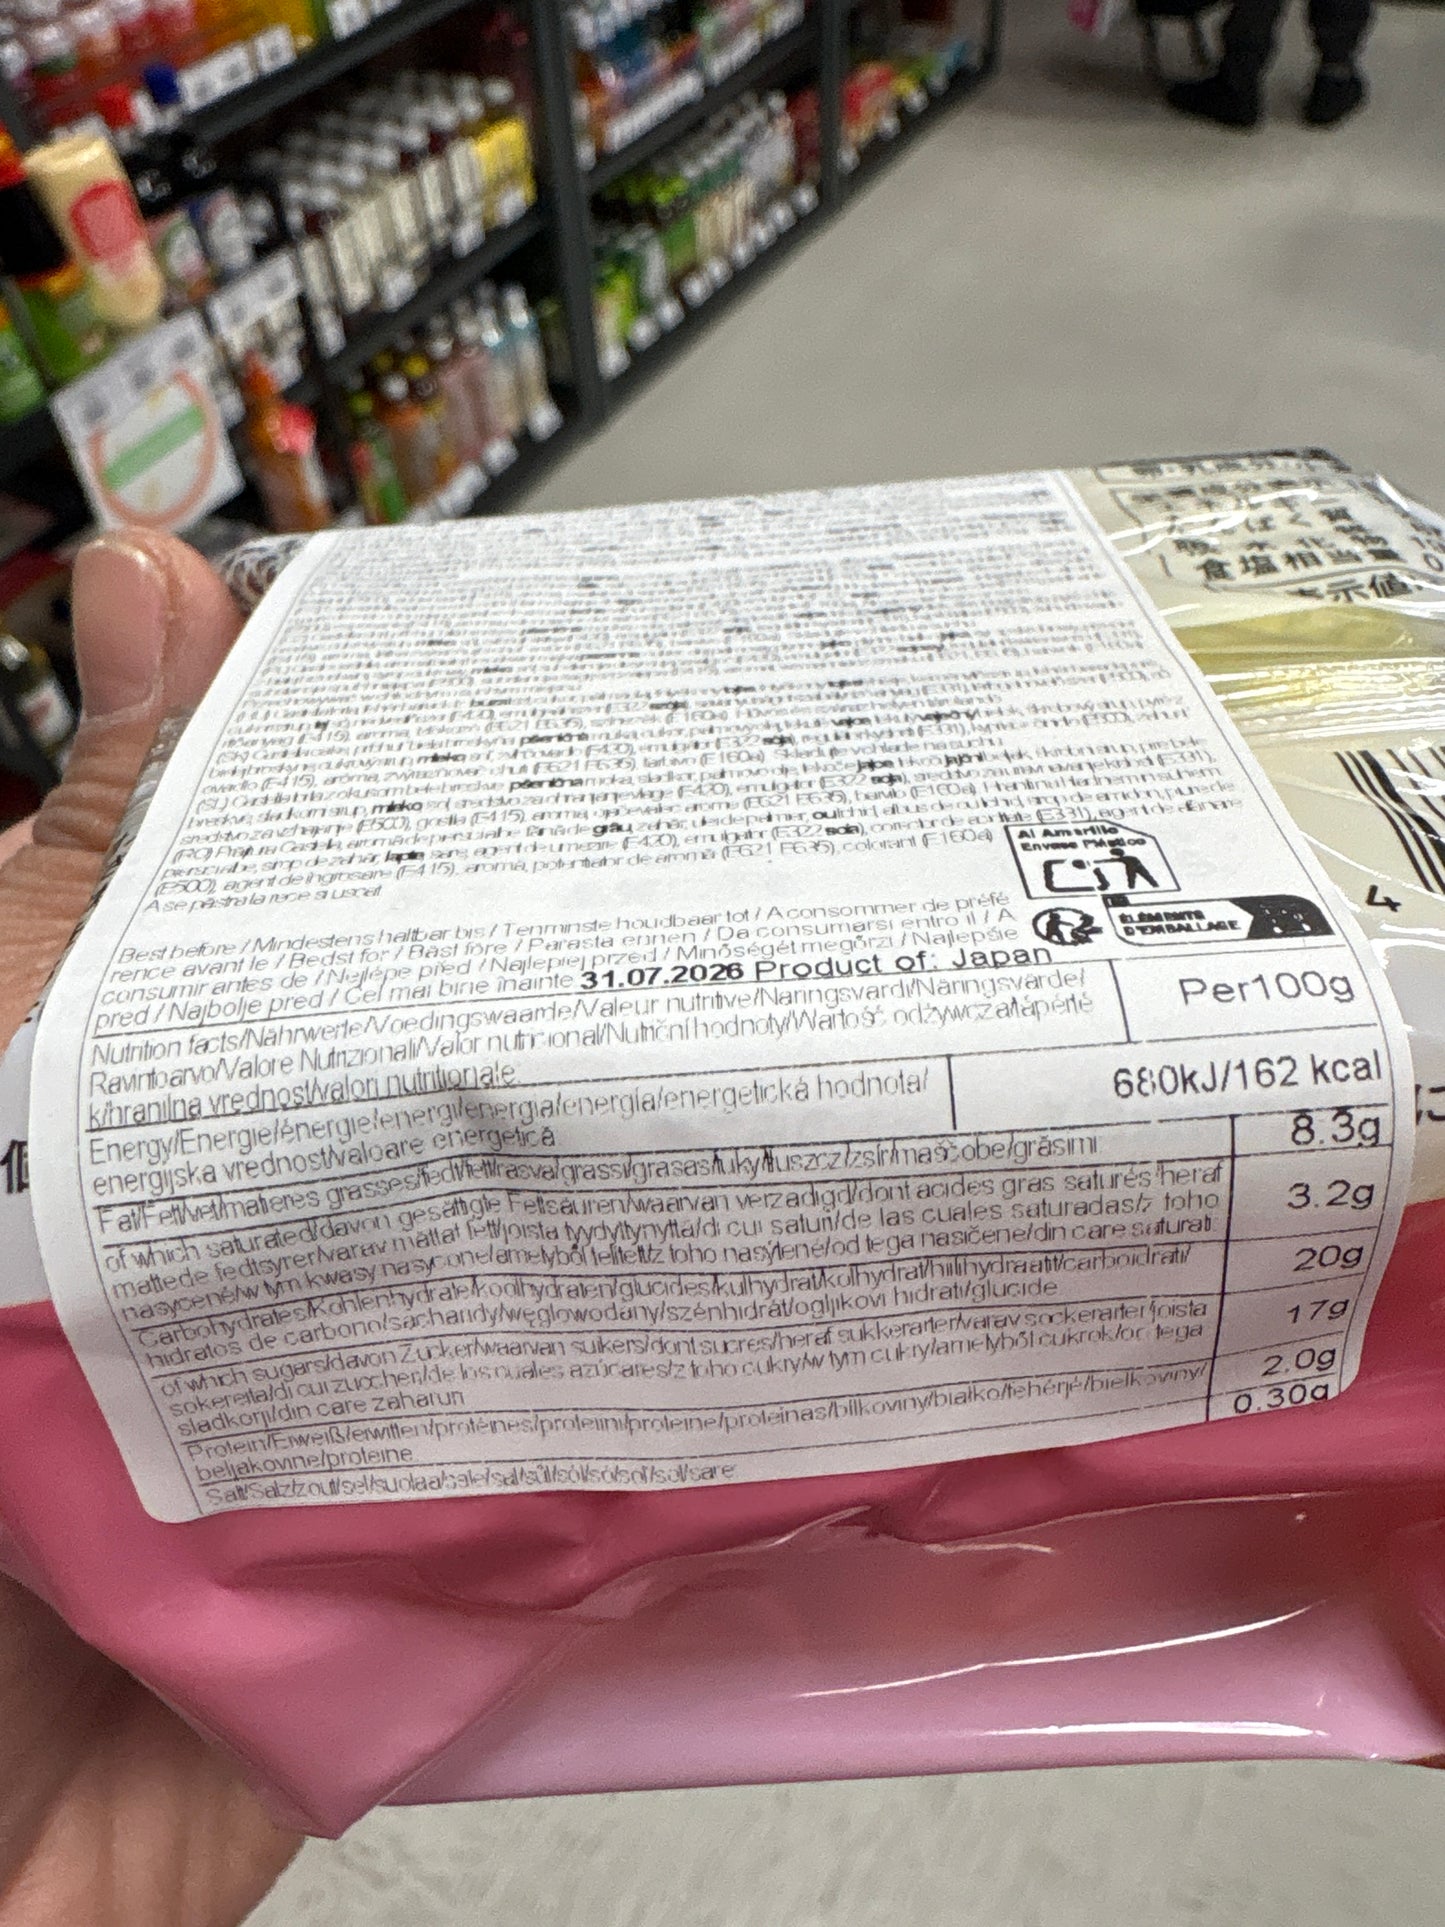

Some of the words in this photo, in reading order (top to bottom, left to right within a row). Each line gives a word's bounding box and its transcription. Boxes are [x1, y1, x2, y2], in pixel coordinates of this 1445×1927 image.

[110, 966, 177, 983] rence
[182, 957, 245, 978] avant
[249, 955, 269, 972] le
[527, 934, 614, 952] Parasta
[756, 918, 893, 939] consumarsi
[901, 912, 959, 929] entro
[118, 946, 168, 964] Best
[169, 942, 237, 959] before
[251, 933, 377, 953] Mindestens
[377, 926, 450, 945] haltbar
[454, 924, 485, 940] bis
[503, 918, 610, 938] Tenminste
[616, 913, 723, 931] houdbaar
[727, 908, 750, 924] tot
[786, 902, 914, 920] consommer
[921, 898, 950, 914] de
[93, 1003, 151, 1036] pred
[267, 989, 325, 1019] pred
[580, 962, 746, 991] 31.07.2026
[755, 954, 883, 981] Product
[951, 948, 1053, 969] Japan
[100, 983, 209, 1006] consumir
[211, 975, 273, 996] antes
[280, 971, 308, 989] de
[90, 1039, 182, 1068] Nutrition
[1311, 1049, 1383, 1085] kcal
[1290, 1107, 1381, 1148] 8.3g
[881, 1206, 917, 1228] las
[921, 1200, 1003, 1225] cuales
[1164, 1189, 1220, 1212] toho
[1287, 1179, 1375, 1211] 3.2g
[131, 1238, 201, 1269] which
[915, 1175, 995, 1200] acides
[1001, 1175, 1055, 1200] gras
[1071, 1223, 1127, 1242] care
[1293, 1244, 1365, 1272] 20g
[1286, 1299, 1350, 1325] 17g
[247, 1333, 278, 1352] de
[1262, 1347, 1337, 1377] 2.0g
[316, 1397, 367, 1418] care
